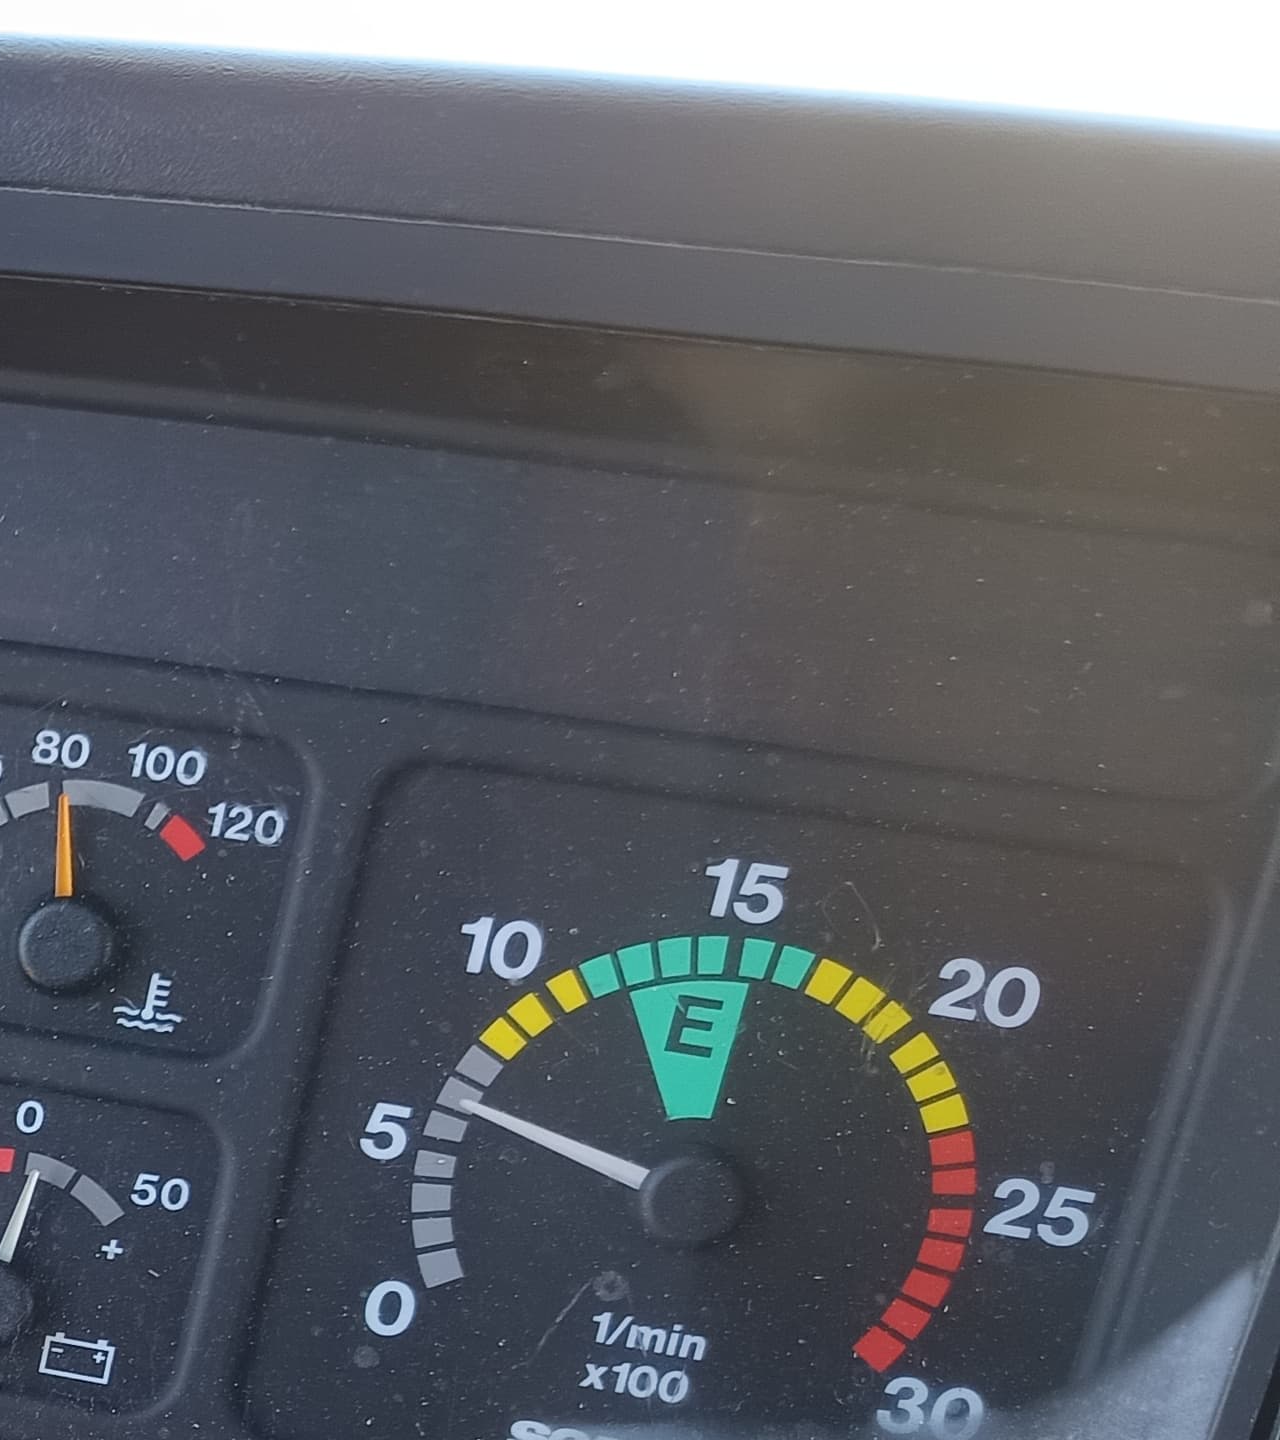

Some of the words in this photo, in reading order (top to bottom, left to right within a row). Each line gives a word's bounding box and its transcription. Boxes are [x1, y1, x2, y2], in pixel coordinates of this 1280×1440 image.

[30, 728, 91, 770] 80
[126, 741, 208, 787] 100
[207, 801, 286, 847] 120
[704, 857, 791, 925] 15
[459, 915, 544, 982] 10
[926, 956, 1042, 1029] 20
[662, 993, 726, 1060] E
[15, 1099, 46, 1135] 0
[358, 1101, 413, 1161] 5
[129, 1172, 191, 1212] 50
[982, 1177, 1097, 1248] 25
[363, 1279, 417, 1337] 0
[591, 1310, 708, 1362] 1/min
[577, 1361, 690, 1405] x100
